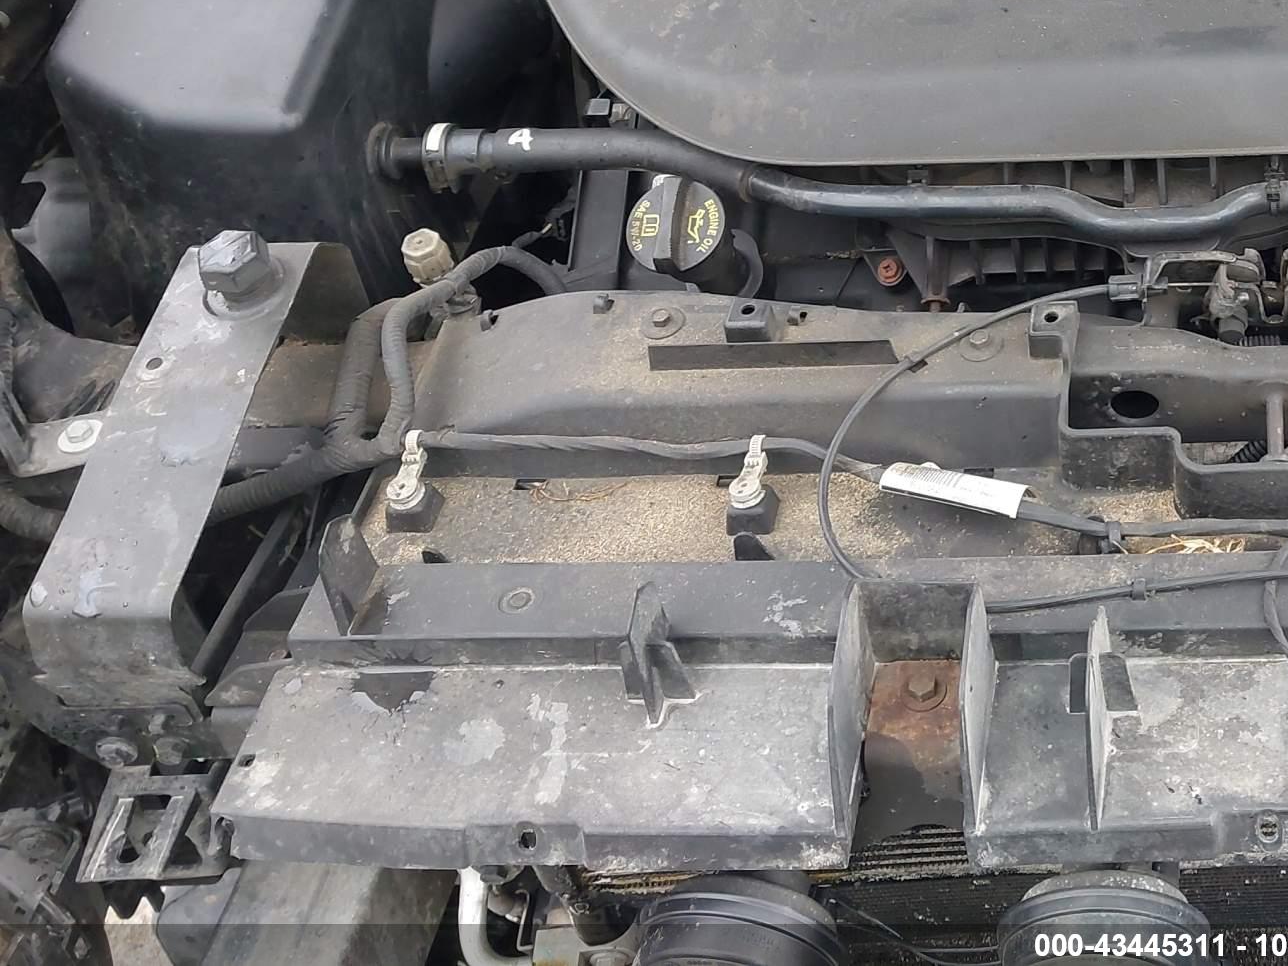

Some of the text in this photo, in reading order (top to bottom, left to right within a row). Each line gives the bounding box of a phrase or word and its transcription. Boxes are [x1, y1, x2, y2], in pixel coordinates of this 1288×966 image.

[633, 199, 651, 220] SAE
[695, 198, 720, 253] ENGINE OIL
